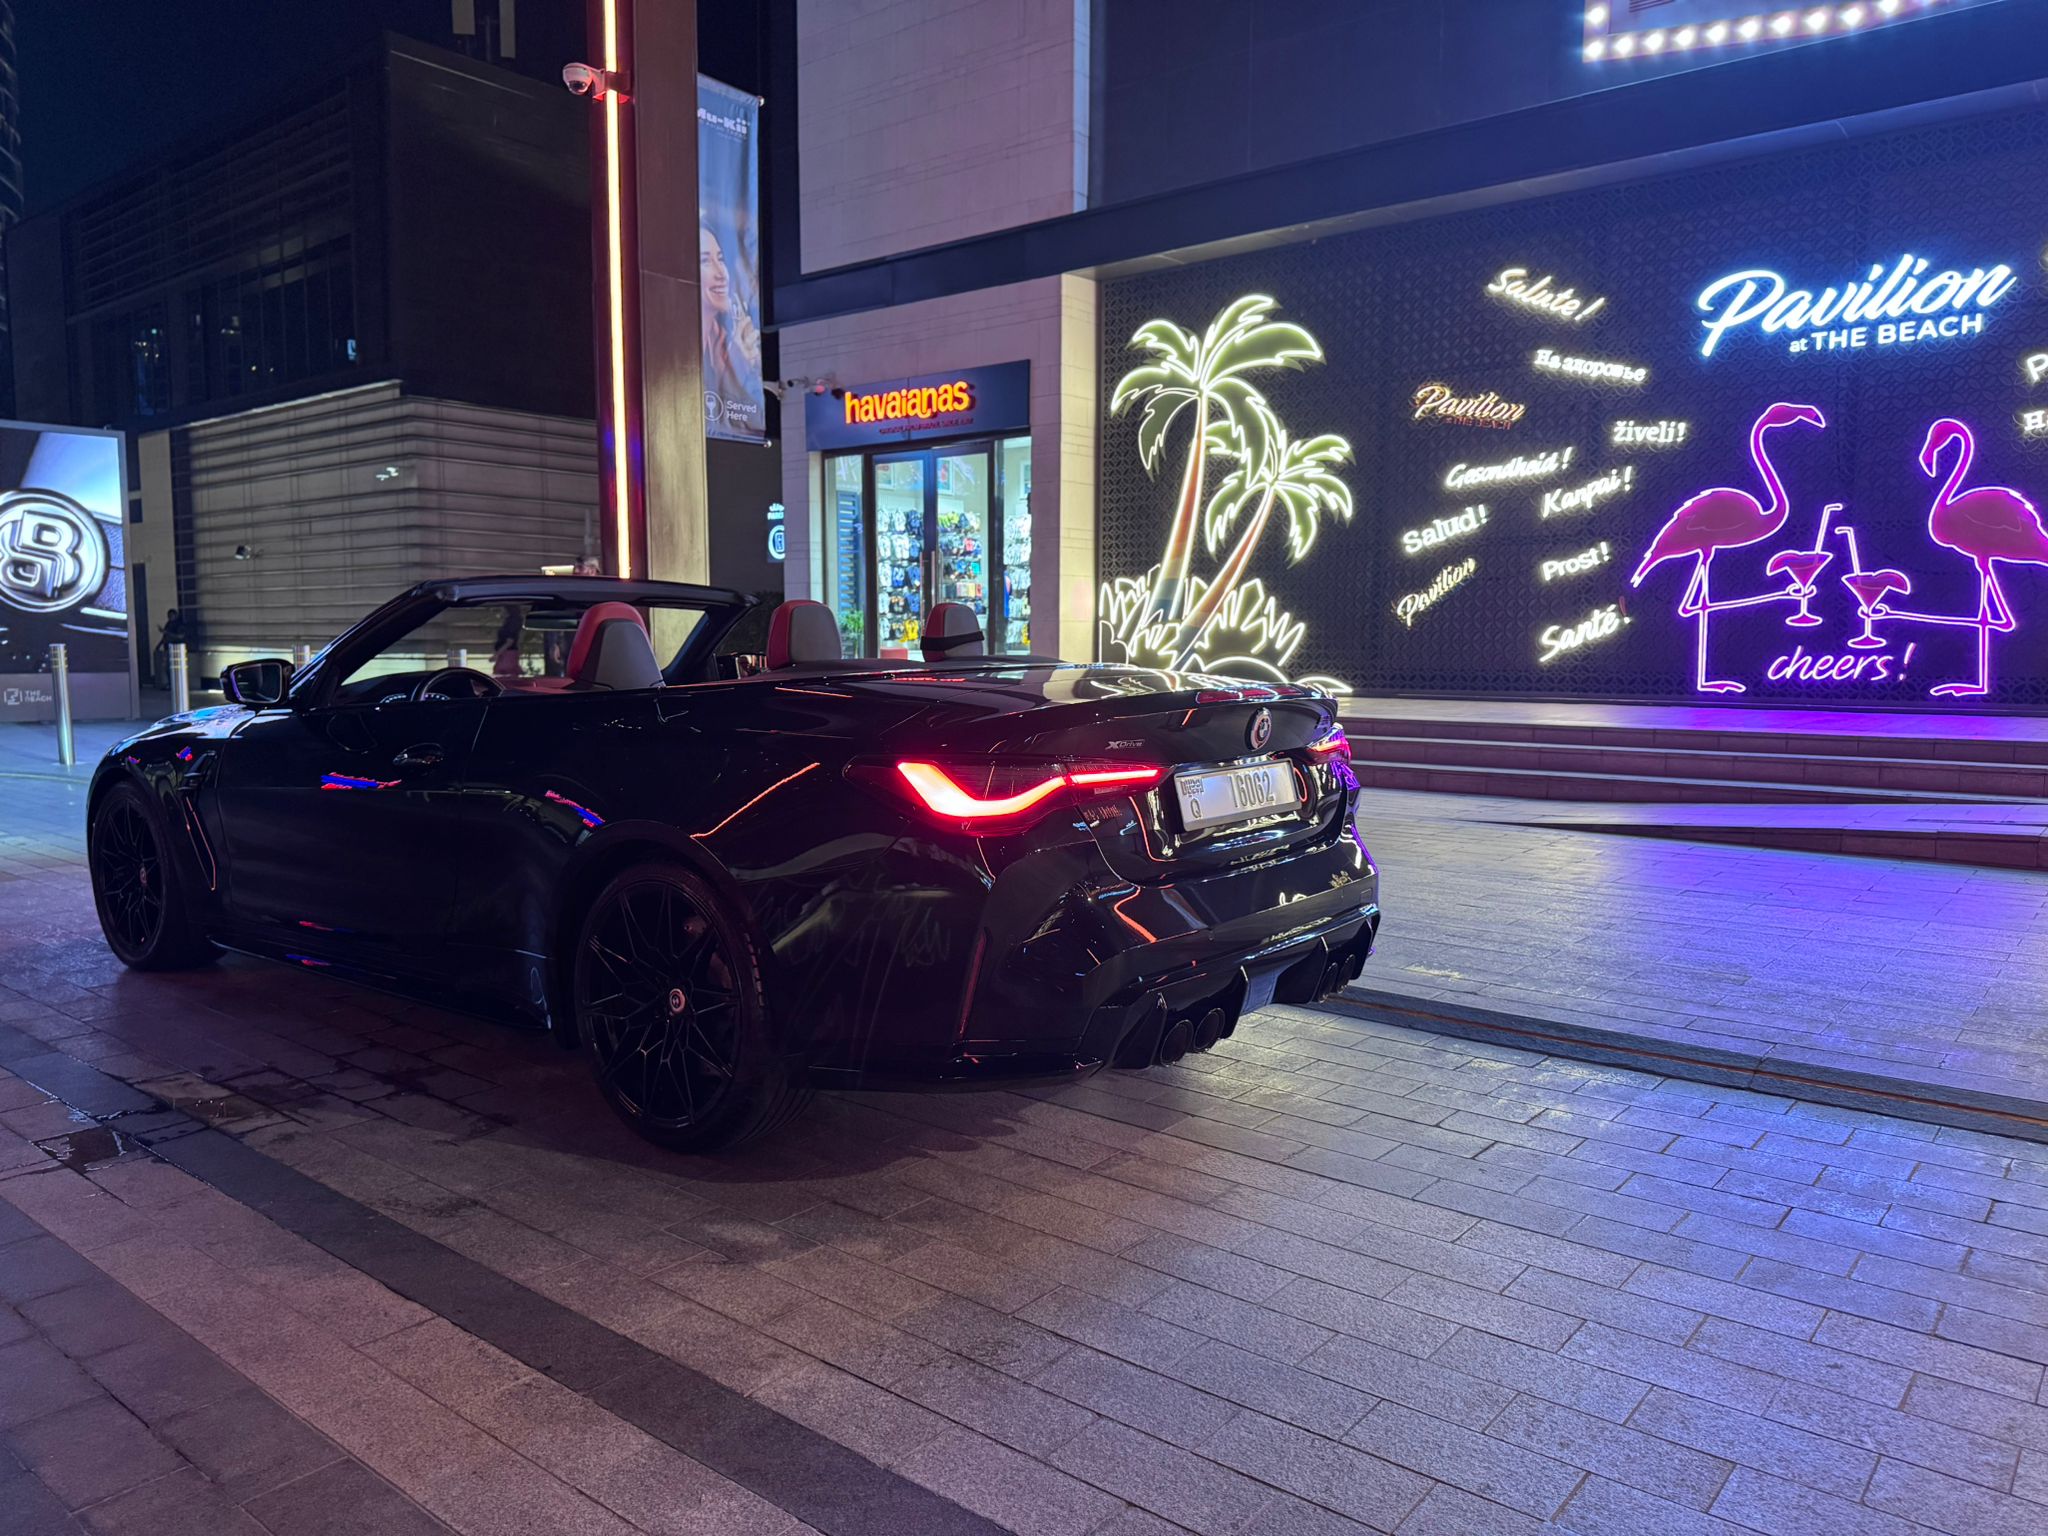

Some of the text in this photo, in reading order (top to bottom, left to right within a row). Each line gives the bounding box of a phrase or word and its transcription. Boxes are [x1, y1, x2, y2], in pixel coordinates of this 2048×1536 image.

[1487, 268, 1605, 321] Salute!
[1698, 253, 2018, 357] Pavilion
[1789, 313, 1982, 354] at THE BEACH
[726, 400, 757, 414] Served
[726, 411, 748, 422] Here
[844, 381, 970, 424] havaianas
[1415, 384, 1525, 421] Pavilion
[1402, 504, 1488, 553] Salud!
[1541, 541, 1610, 581] Prost!
[1397, 557, 1477, 627] Pavilion
[1767, 642, 1916, 681] cheers!
[1190, 797, 1202, 819] Q
